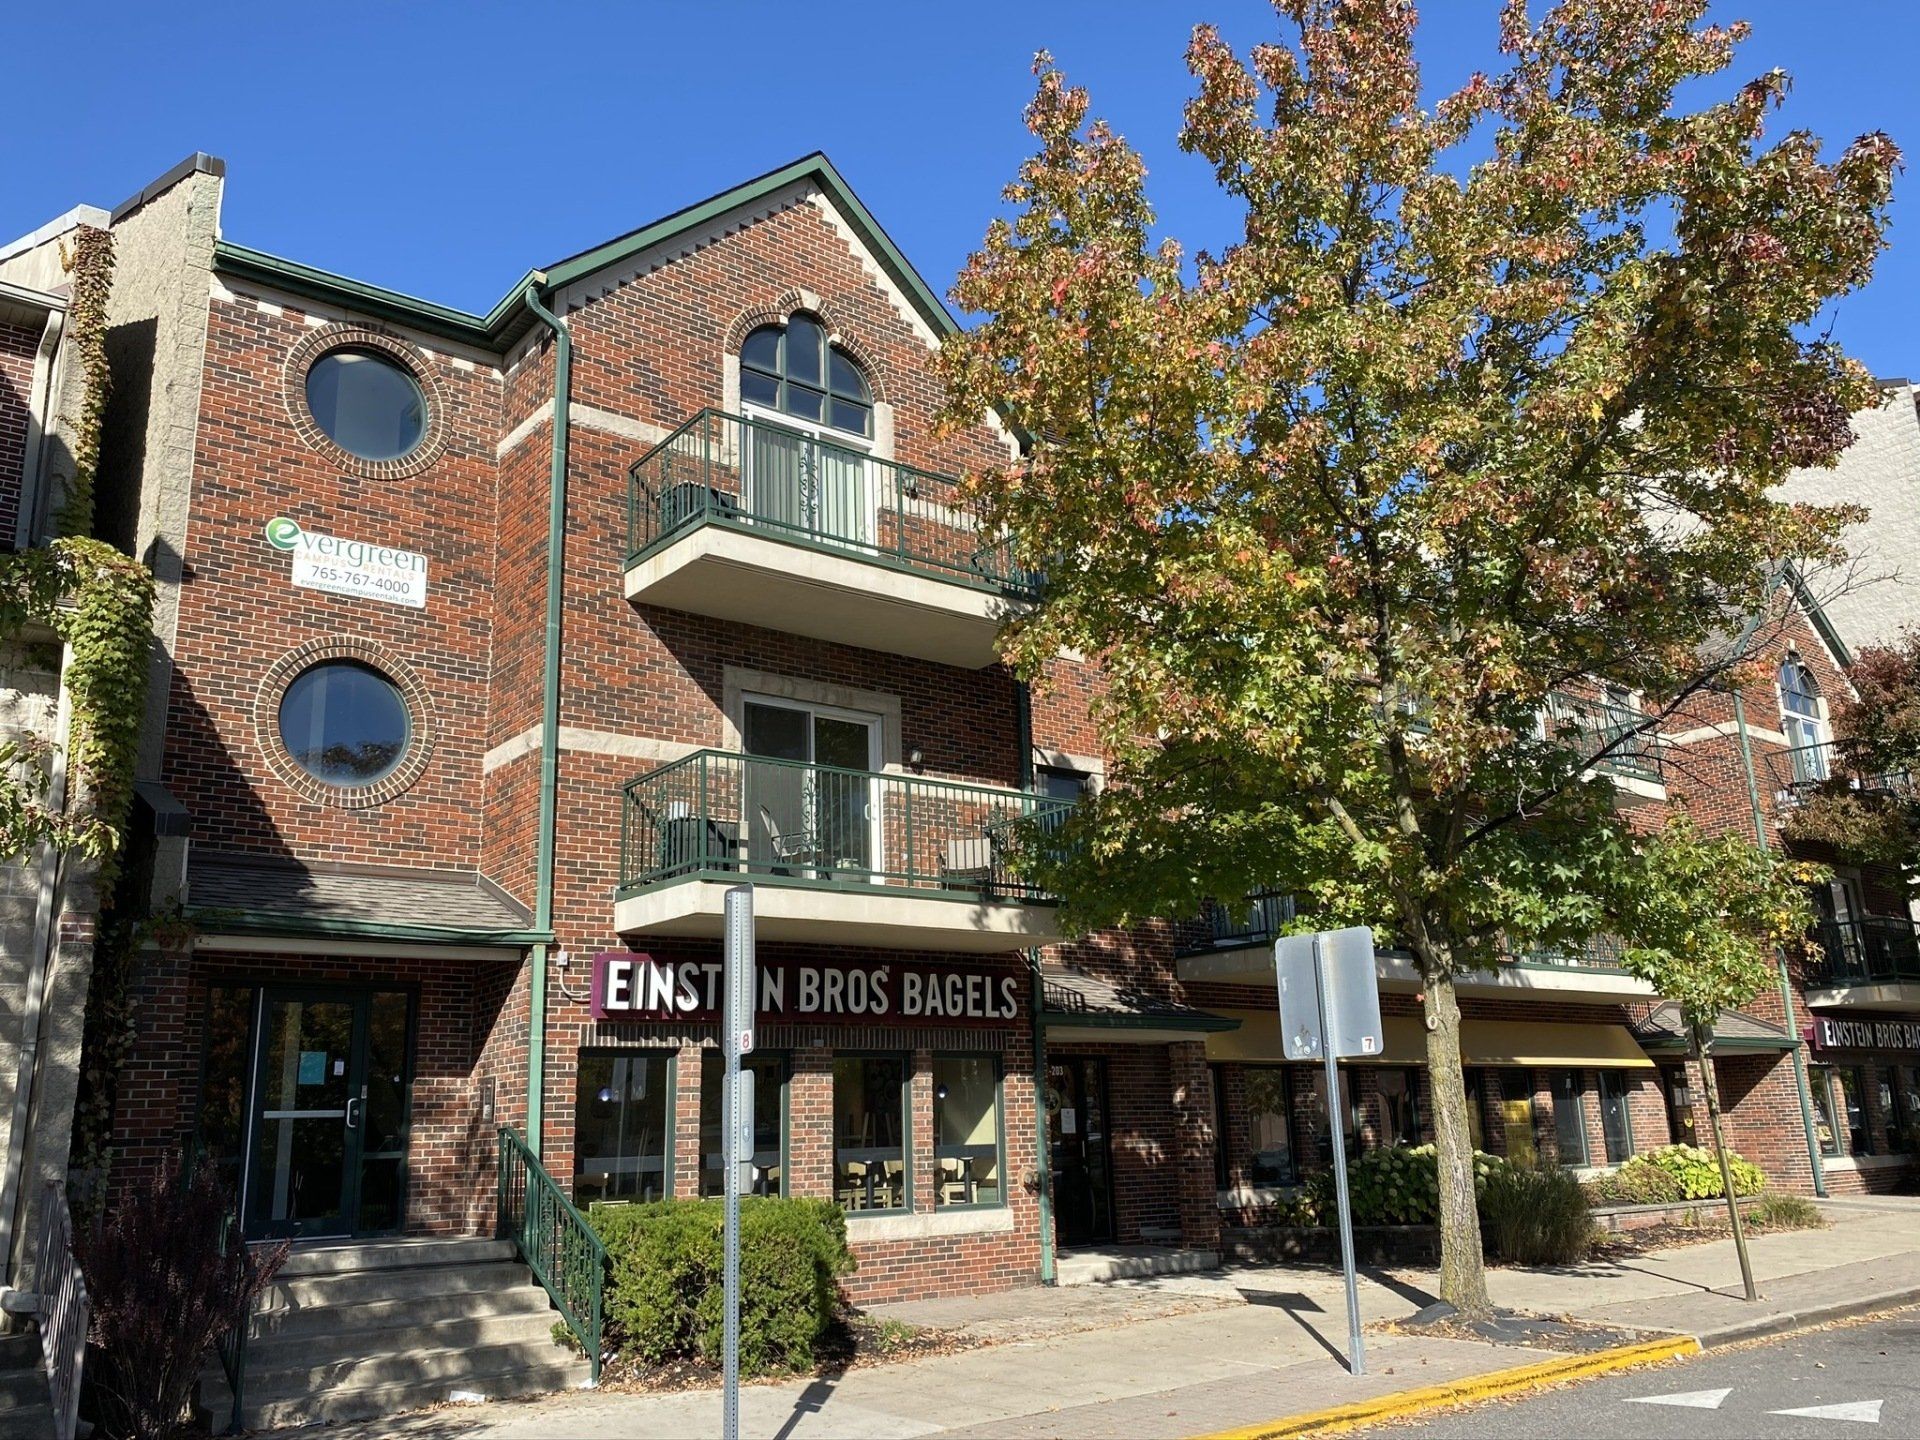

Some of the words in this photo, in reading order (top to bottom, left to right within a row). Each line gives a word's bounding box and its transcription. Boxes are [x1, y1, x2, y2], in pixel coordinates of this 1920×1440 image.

[267, 517, 426, 573] evergreen
[295, 551, 346, 568] CAMPUS
[362, 563, 416, 581] RENTALS
[311, 565, 411, 595] 765-767-4000
[300, 578, 418, 605] evergreencampusrentals.com
[606, 961, 784, 1013] EINSTN
[799, 967, 889, 1015] BROS
[903, 972, 1018, 1020] BAGELS
[742, 1033, 750, 1049] 8
[1365, 1039, 1372, 1050] 7
[1823, 1020, 1874, 1048] EINSTEIN
[1875, 1023, 1904, 1049] BROS
